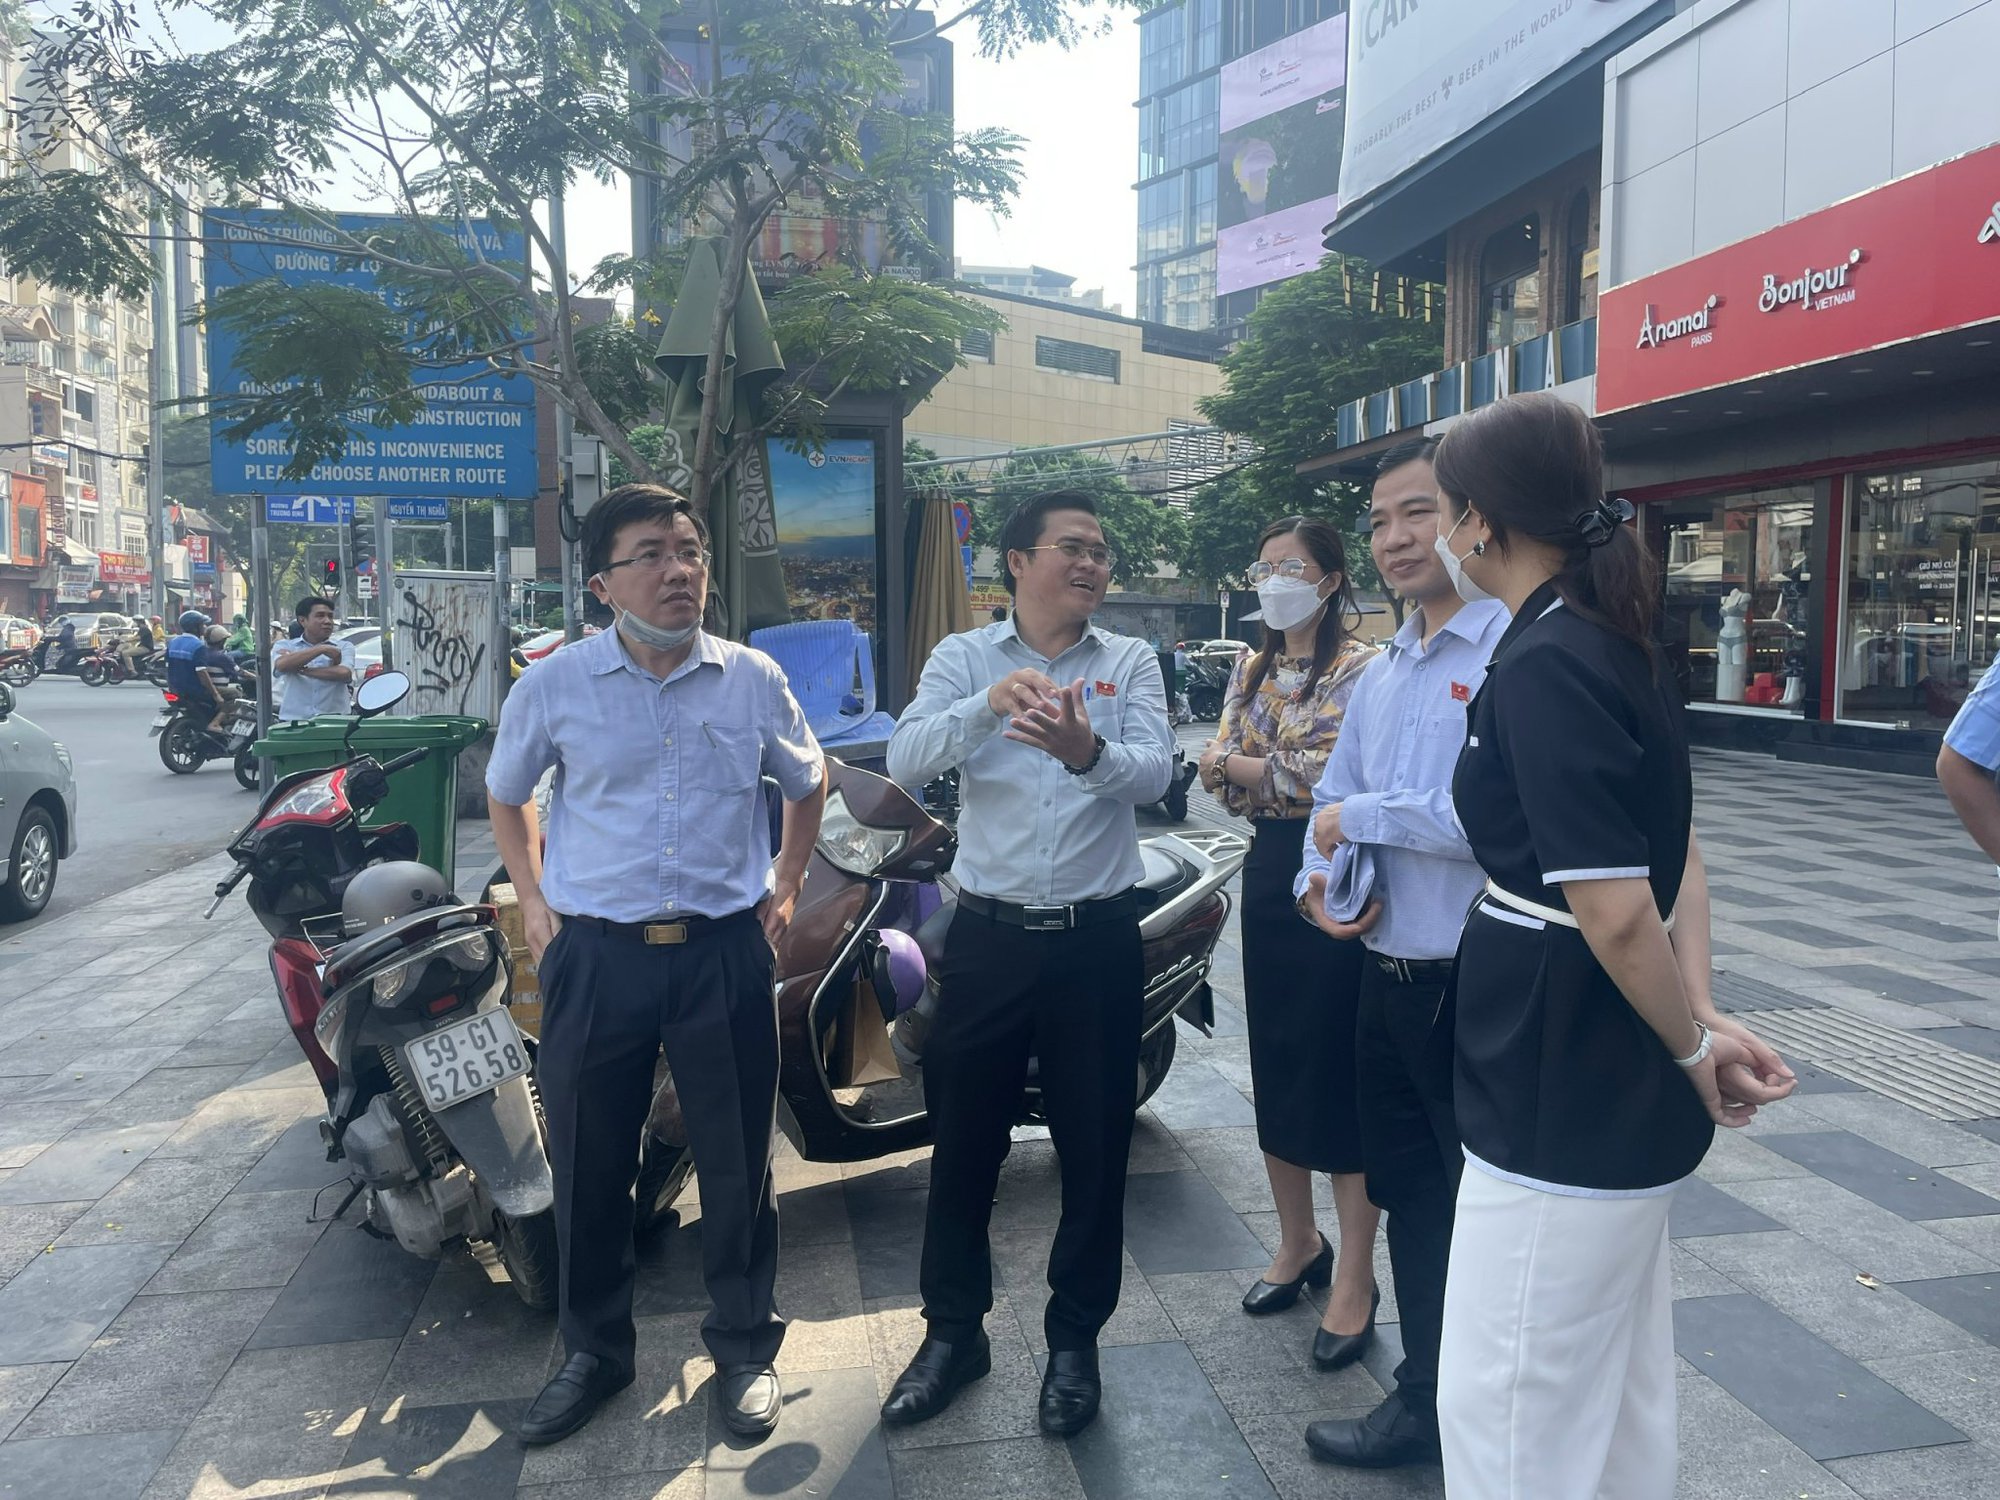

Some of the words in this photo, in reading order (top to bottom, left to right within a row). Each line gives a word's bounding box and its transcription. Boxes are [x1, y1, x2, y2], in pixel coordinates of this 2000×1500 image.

[1354, 122, 1394, 158] PROBABLY
[1396, 110, 1413, 128] THE
[1415, 91, 1437, 115] BEST
[1459, 59, 1485, 86] BEER
[1489, 48, 1500, 66] IN
[1504, 30, 1525, 54] THE
[1530, 0, 1573, 35] WORLD
[483, 231, 503, 250] VÀ
[1758, 248, 1862, 313] Bonjour
[1814, 289, 1856, 312] VIETNAM
[1636, 294, 1717, 350] Anamai
[1690, 332, 1713, 349] PARIS
[493, 387, 505, 401] &
[1355, 330, 1560, 443] KATINA
[381, 442, 505, 460] INCONVENIENCE
[245, 464, 306, 481] PLEA
[311, 465, 374, 481] CHOOSE
[378, 467, 450, 483] ANOTHER
[455, 467, 507, 484] ROUTE
[422, 1016, 498, 1069] 59-G1
[426, 1043, 522, 1103] 526.58
